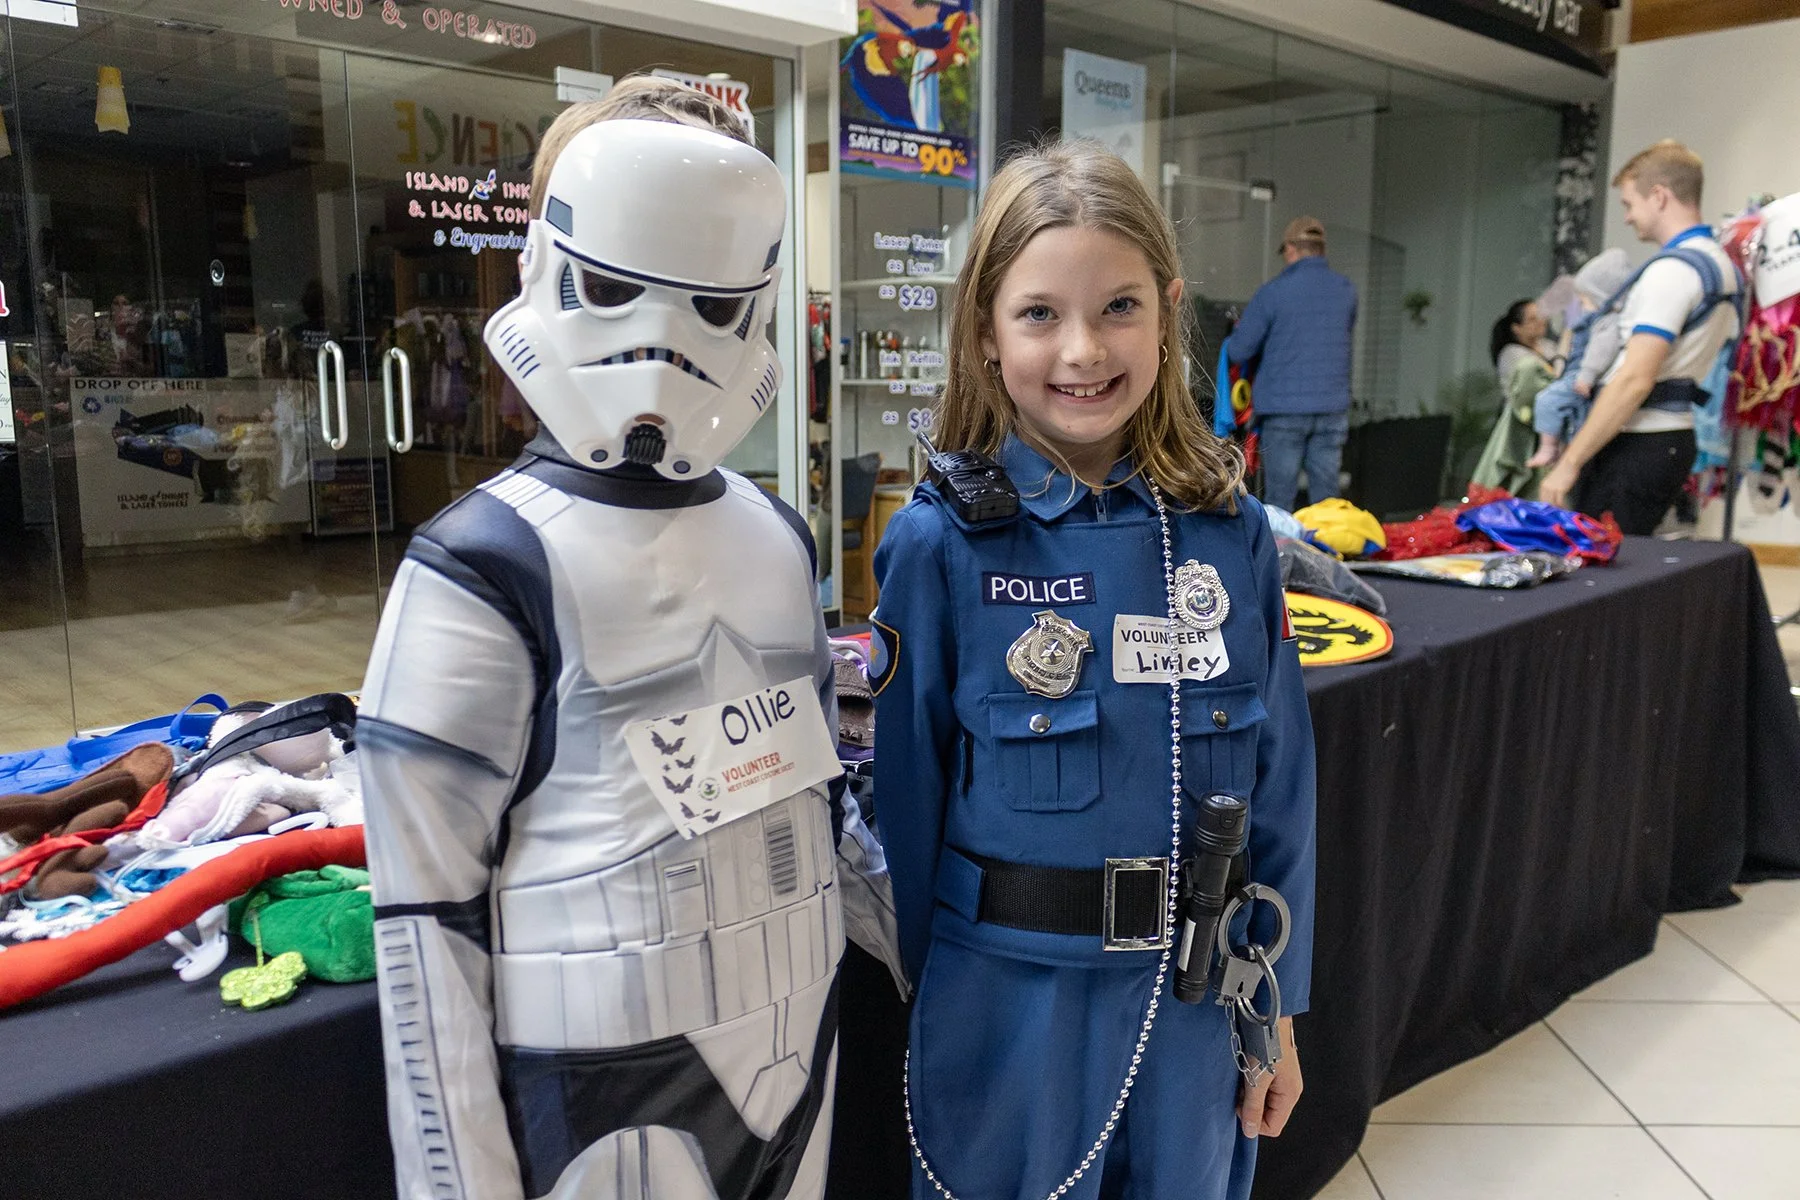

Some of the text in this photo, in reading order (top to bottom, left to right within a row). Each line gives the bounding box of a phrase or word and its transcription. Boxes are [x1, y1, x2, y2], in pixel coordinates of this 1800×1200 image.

[381, 0, 407, 29] &
[422, 7, 537, 49] OPERATED
[848, 132, 881, 152] SAVE
[881, 138, 900, 154] UP
[901, 141, 919, 158] TO
[918, 143, 968, 176] 90%
[406, 171, 531, 200] ISLAND INK
[408, 199, 530, 224] & LASER TON
[433, 226, 528, 255] & Engravin
[874, 232, 911, 250] Laser
[886, 259, 904, 273] as
[879, 284, 937, 311] as $29
[74, 379, 122, 390] DROP
[164, 379, 202, 390] HERE
[889, 381, 906, 394] as
[882, 411, 899, 425] as
[991, 576, 1086, 602] POLICE
[721, 689, 796, 746] Ollie
[721, 752, 782, 783] VOLUNTEER
[727, 782, 742, 793] WEST
[743, 776, 760, 788] COAST
